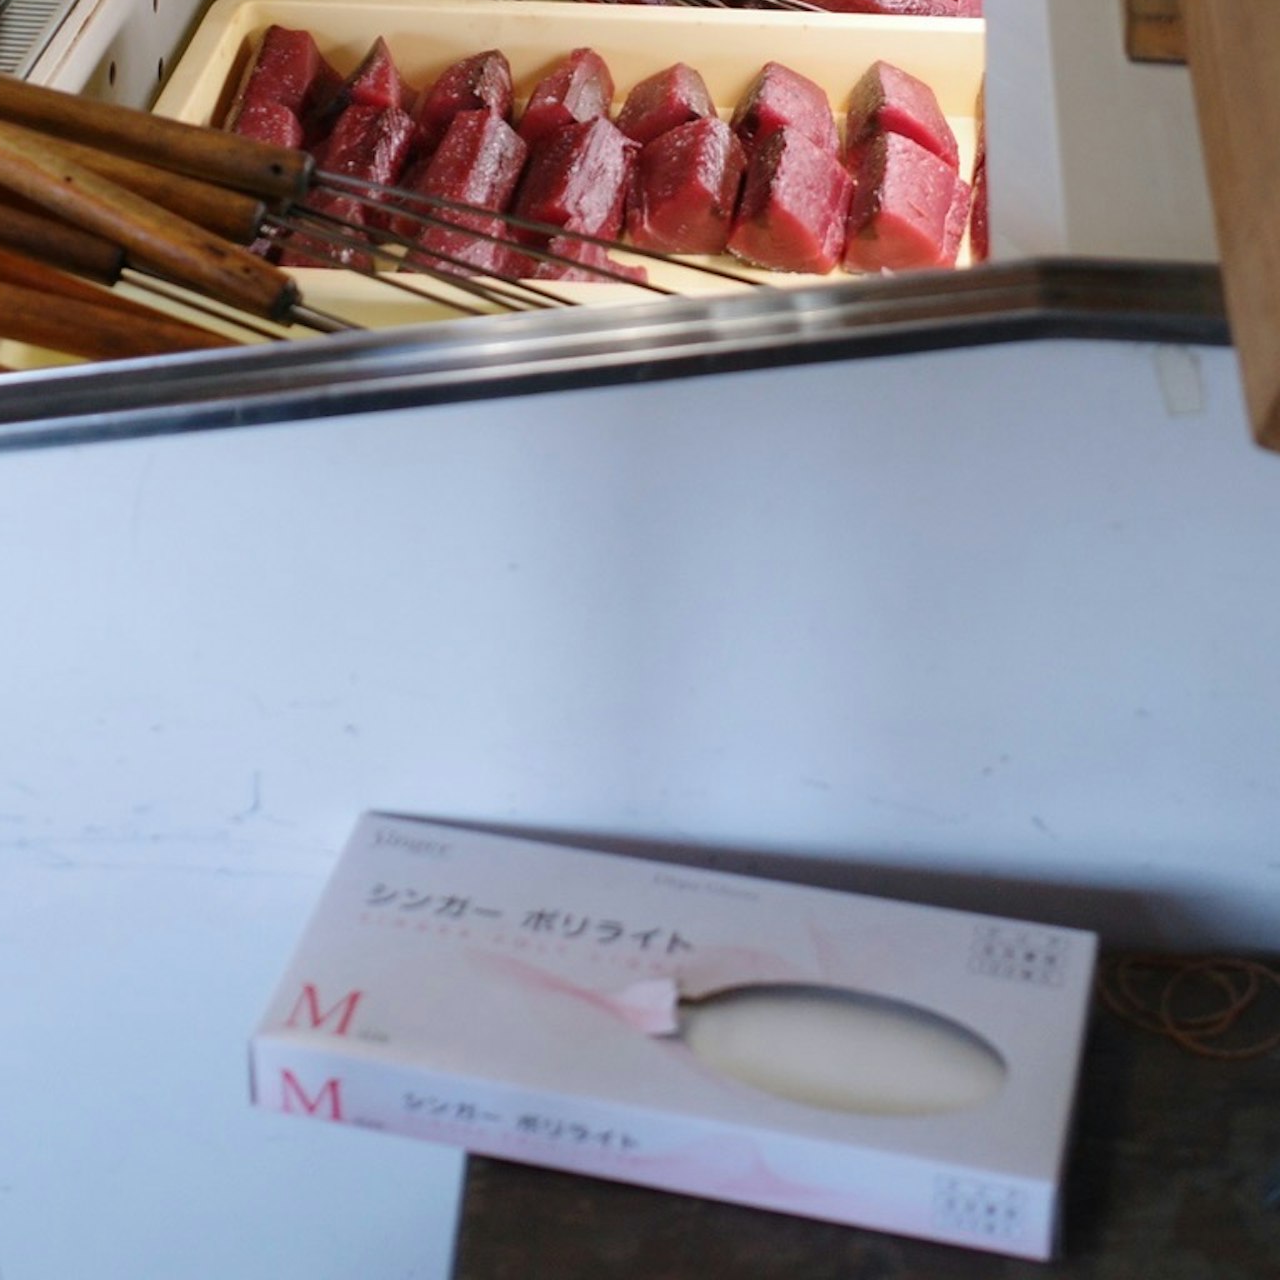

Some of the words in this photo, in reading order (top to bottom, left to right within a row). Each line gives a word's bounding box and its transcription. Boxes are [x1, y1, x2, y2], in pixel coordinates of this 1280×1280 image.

[366, 882, 503, 919] シンガー
[284, 981, 363, 1038] M
[280, 1067, 345, 1122] M
